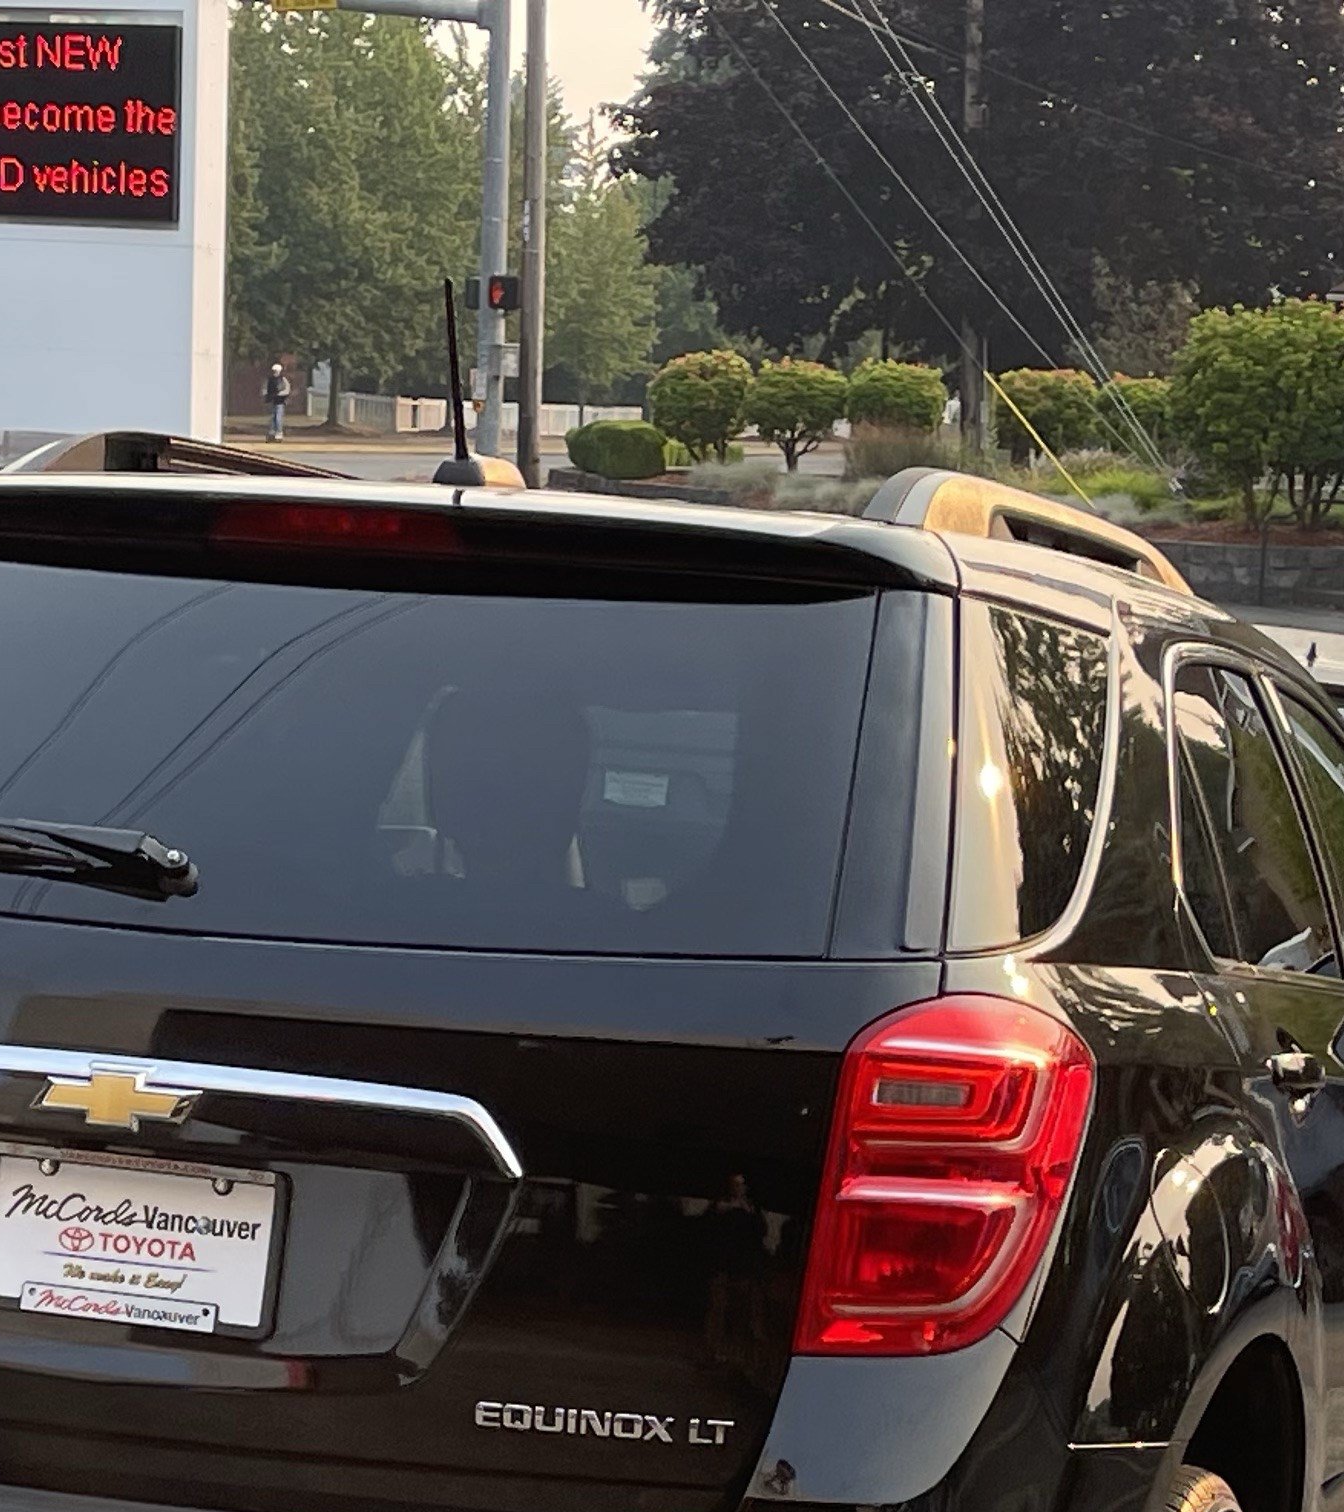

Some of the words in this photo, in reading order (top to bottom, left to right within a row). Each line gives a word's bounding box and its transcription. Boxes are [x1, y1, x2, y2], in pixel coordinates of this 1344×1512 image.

[36, 34, 123, 72] NEW
[124, 99, 177, 136] the
[32, 158, 170, 198] vehicles
[99, 1231, 197, 1262] TOYOTA
[475, 1400, 676, 1443] EQUINOX
[688, 1417, 735, 1445] LT
